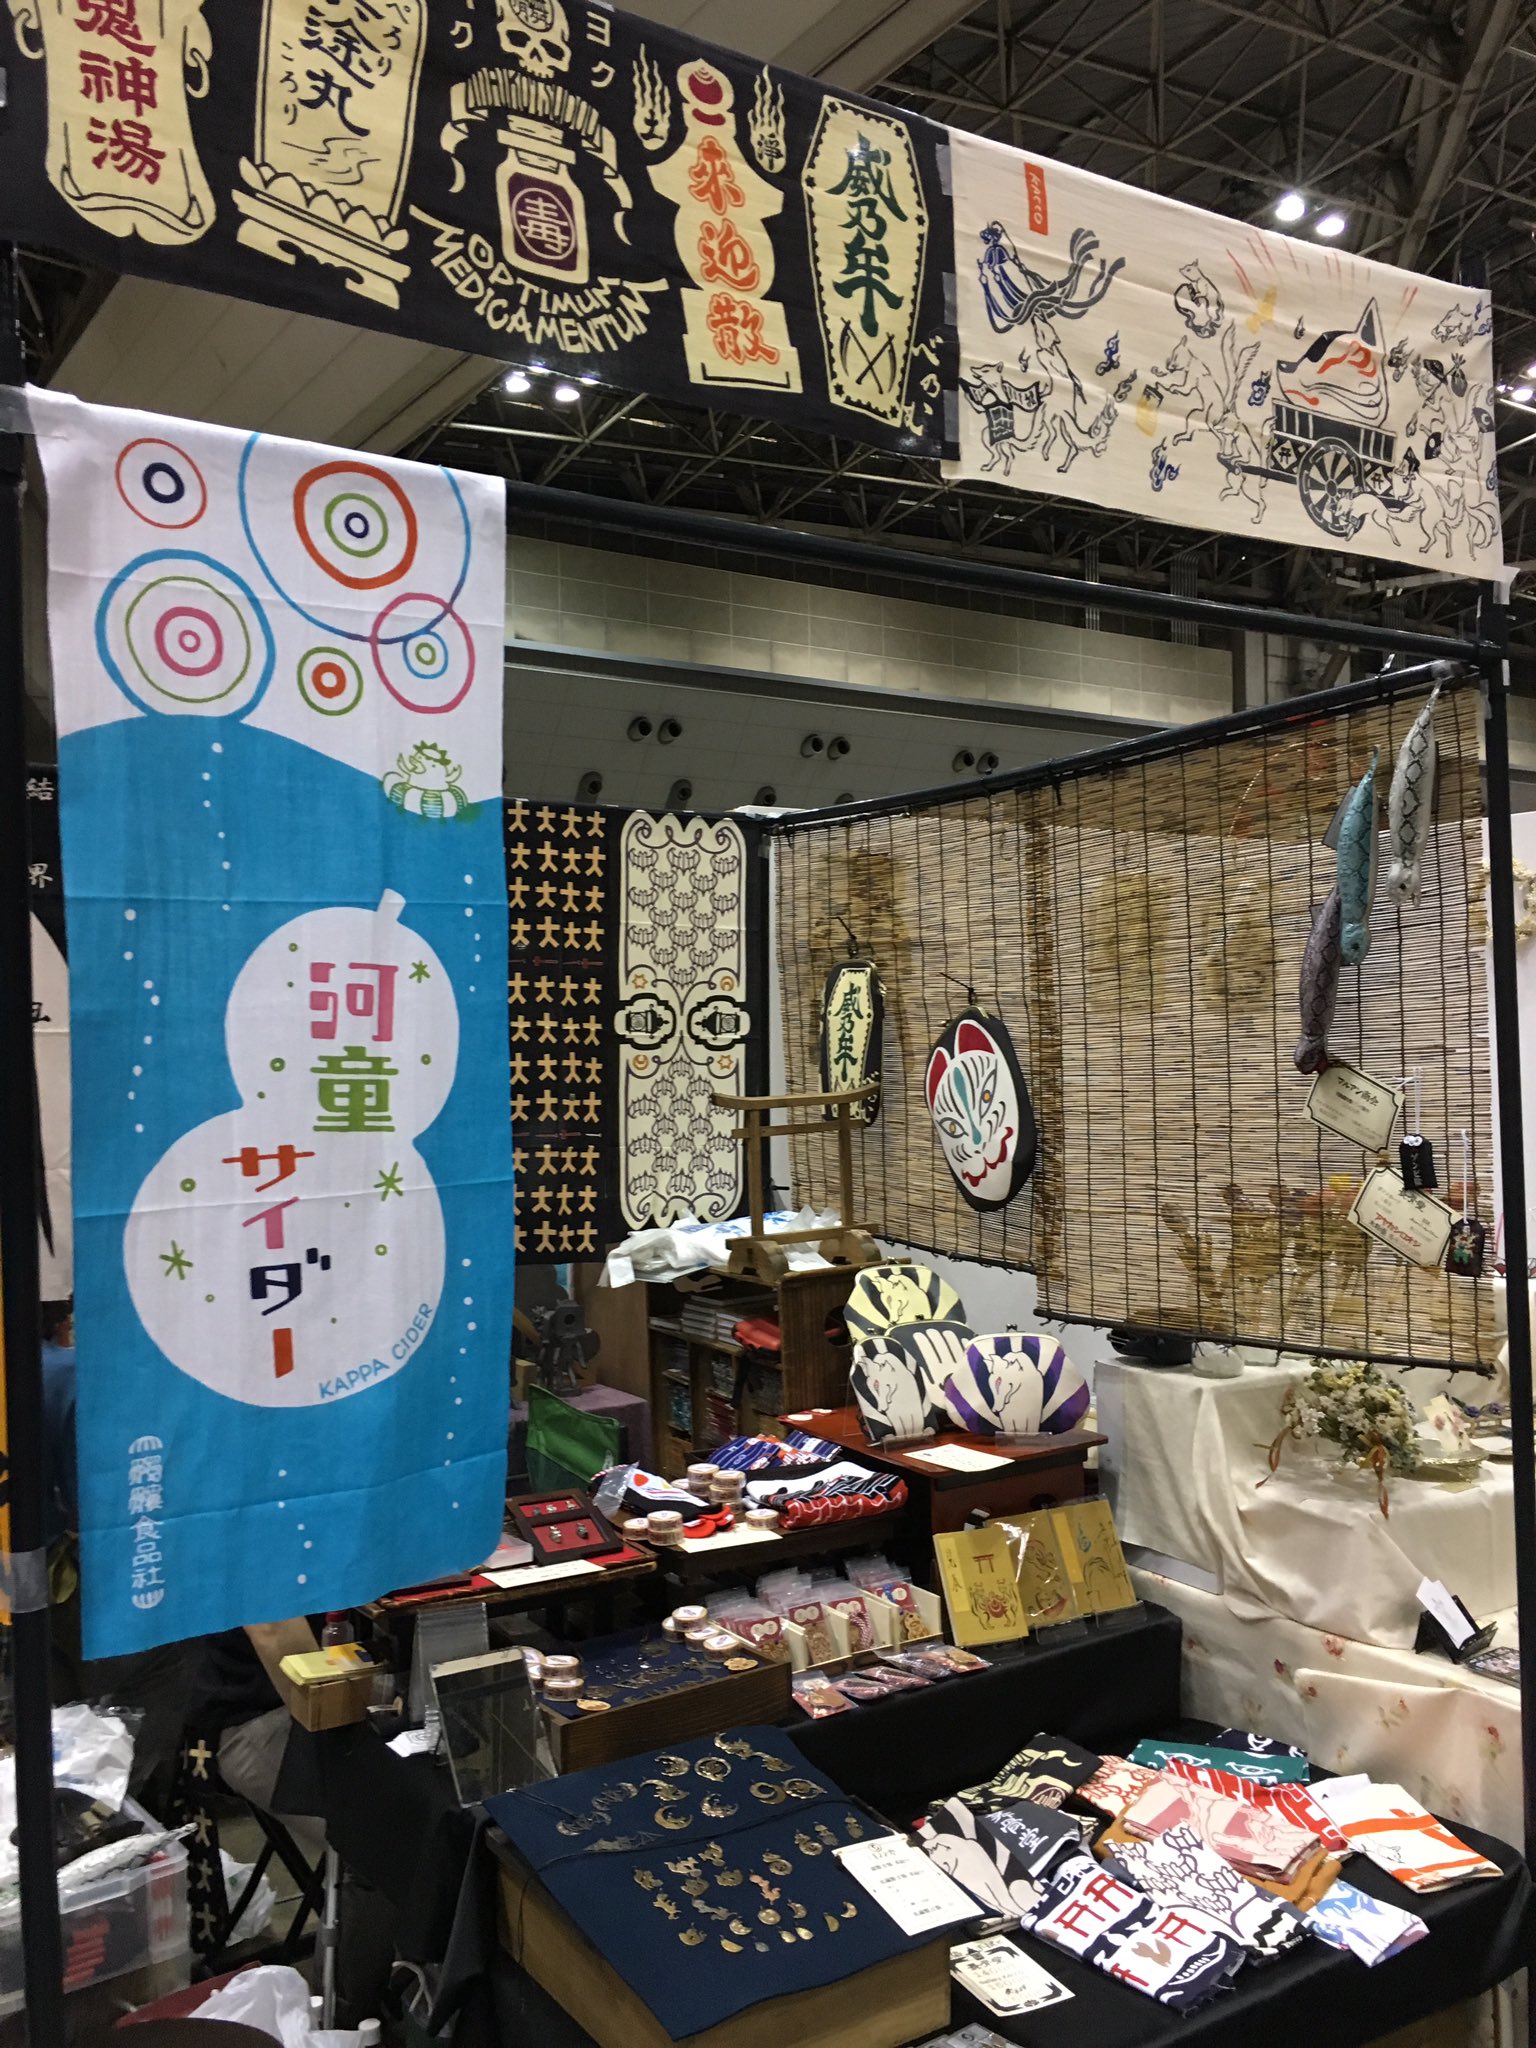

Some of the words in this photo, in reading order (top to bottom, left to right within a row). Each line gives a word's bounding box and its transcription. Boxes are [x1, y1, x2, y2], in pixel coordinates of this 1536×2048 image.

[298, 0, 386, 137] 途丸
[377, 2, 411, 77] ぺろり
[450, 0, 475, 49] ク
[586, 10, 616, 88] ヨク
[280, 41, 299, 126] ころり
[517, 195, 572, 255] 毒
[410, 204, 671, 354] MEDICAMENTUM
[468, 232, 622, 318] OPTIMUM
[25, 777, 55, 890] 結界
[309, 961, 399, 1133] 河童
[221, 1144, 331, 1379] サイダー
[318, 1358, 390, 1399] KAPPA
[391, 1302, 433, 1360] CIDER
